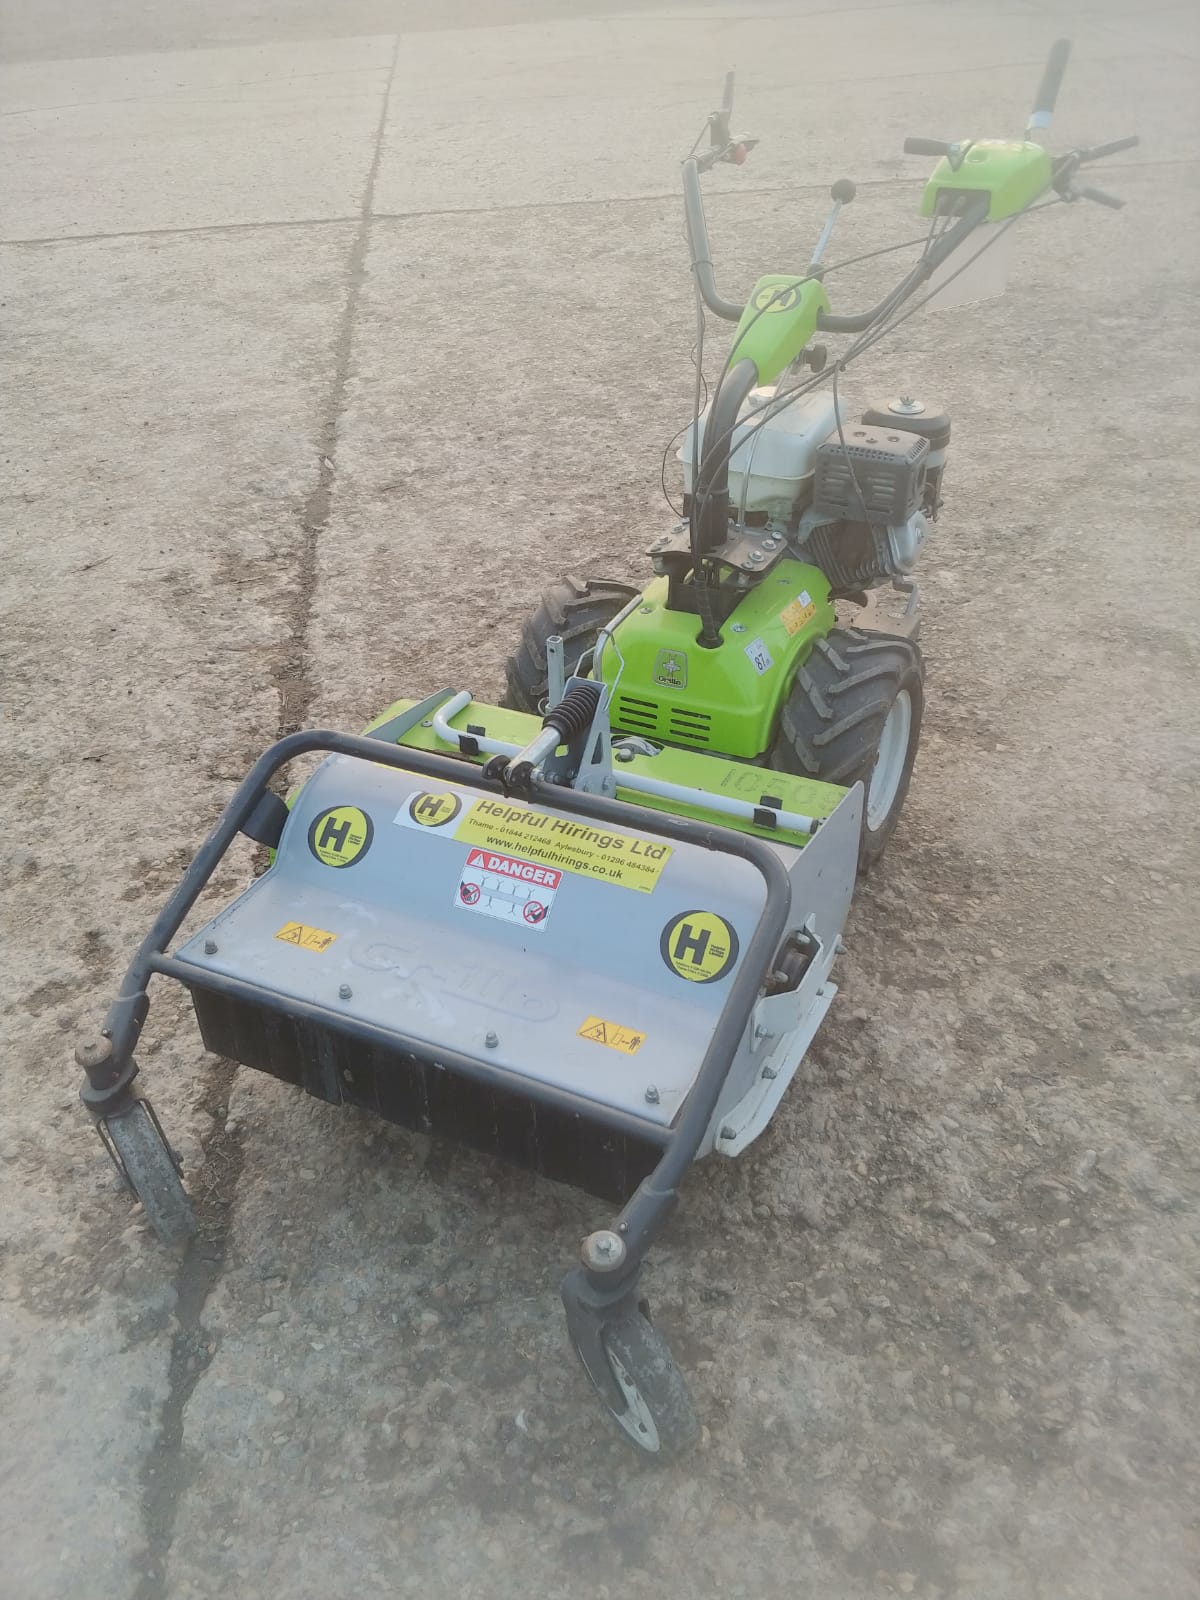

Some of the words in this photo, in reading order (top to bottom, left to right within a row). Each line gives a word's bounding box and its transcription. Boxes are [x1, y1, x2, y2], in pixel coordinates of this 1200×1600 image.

[318, 816, 353, 853] H
[469, 818, 494, 830] Thame
[554, 842, 594, 858] Aylesbury
[476, 801, 549, 829] Helpful
[551, 820, 625, 849] Hirings
[630, 841, 667, 860] Ltd
[486, 835, 624, 880] www.helpfulhirings.co.uk
[487, 856, 557, 886] DANGER
[673, 923, 712, 966] H
